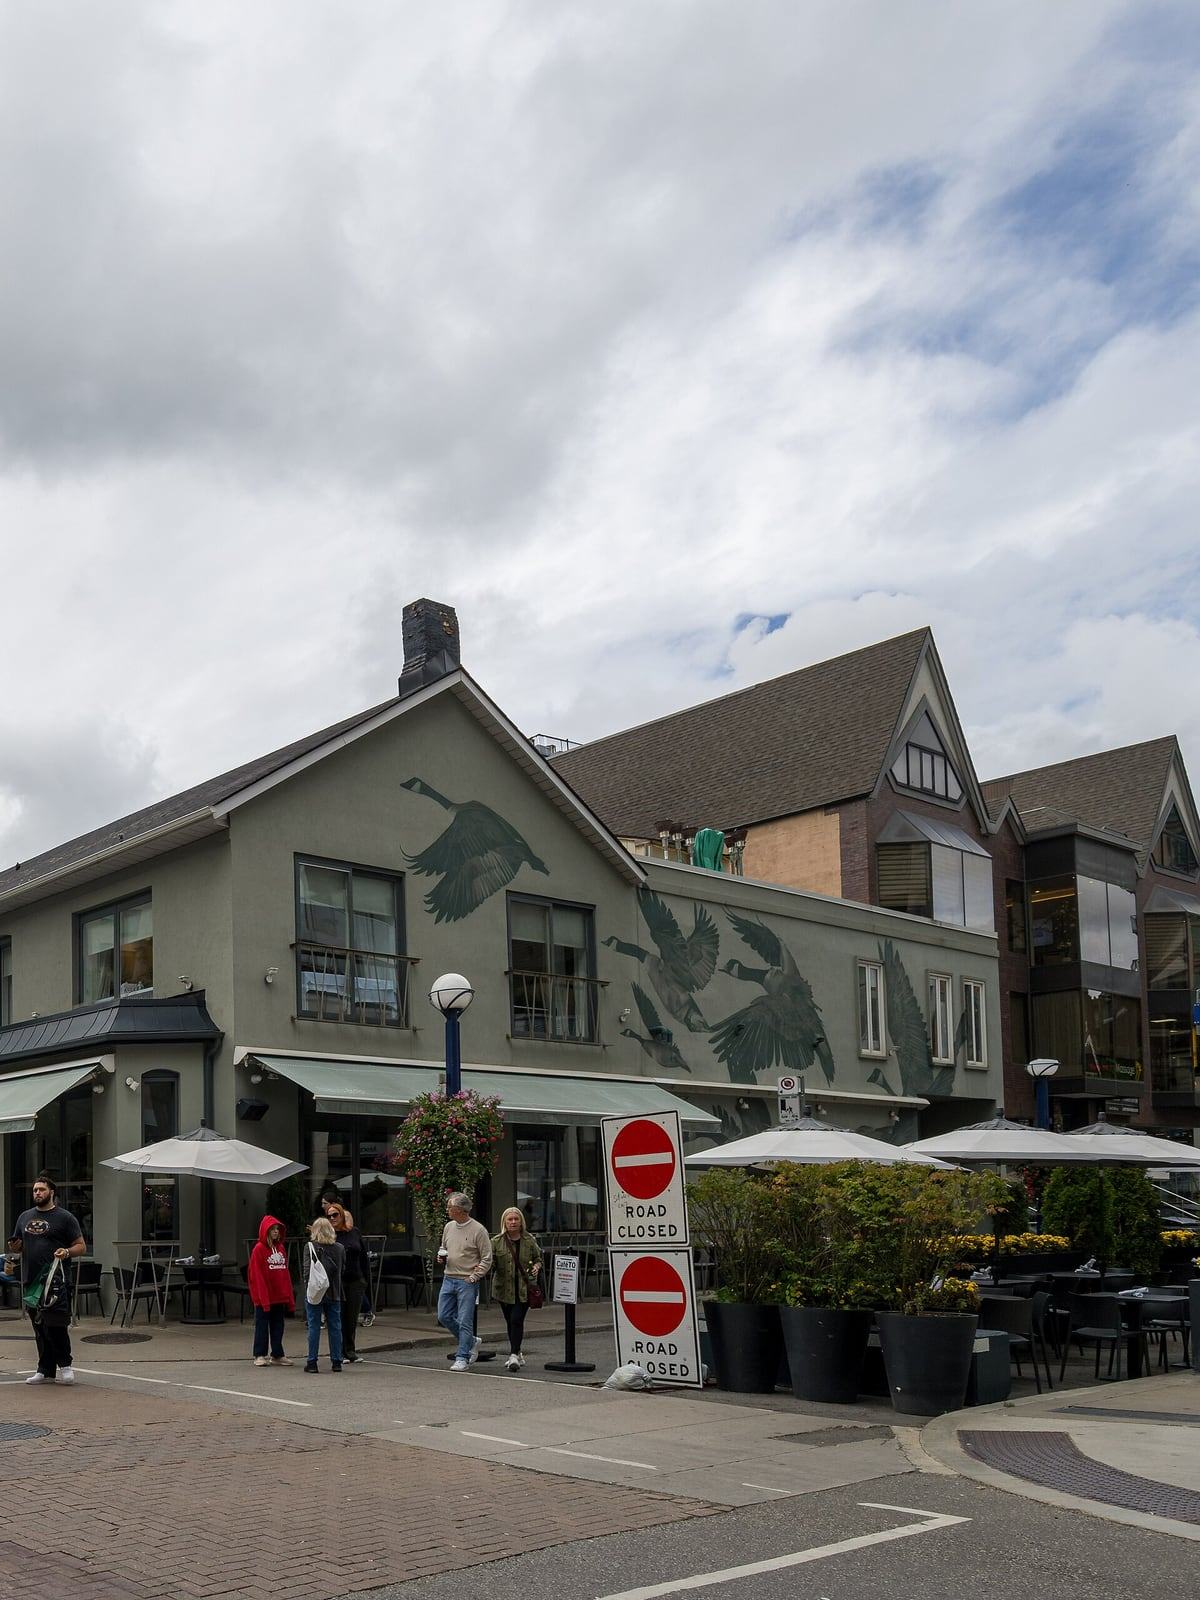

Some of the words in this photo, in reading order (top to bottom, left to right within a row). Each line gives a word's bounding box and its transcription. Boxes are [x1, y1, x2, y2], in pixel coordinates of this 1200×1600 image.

[626, 1204, 667, 1218] ROAD
[618, 1224, 678, 1238] CLOSED
[635, 1341, 678, 1355] ROAD
